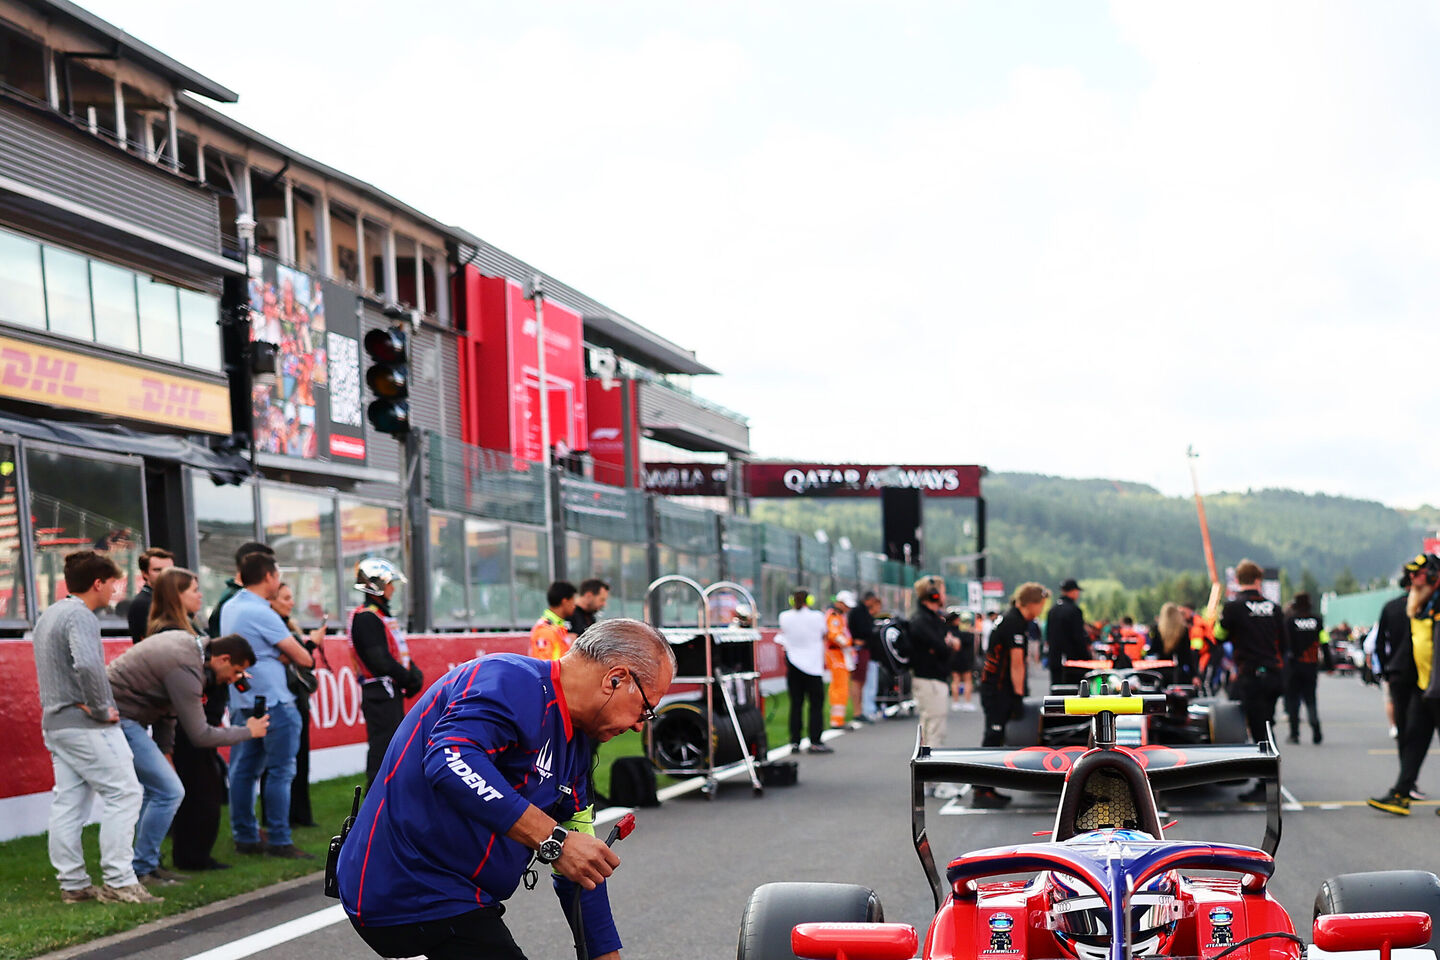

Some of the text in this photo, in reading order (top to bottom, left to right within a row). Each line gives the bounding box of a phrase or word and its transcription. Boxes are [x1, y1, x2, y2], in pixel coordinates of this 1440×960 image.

[0, 349, 84, 399] DHL
[140, 377, 205, 420] DHL
[783, 467, 960, 493] QATAR AWAYS
